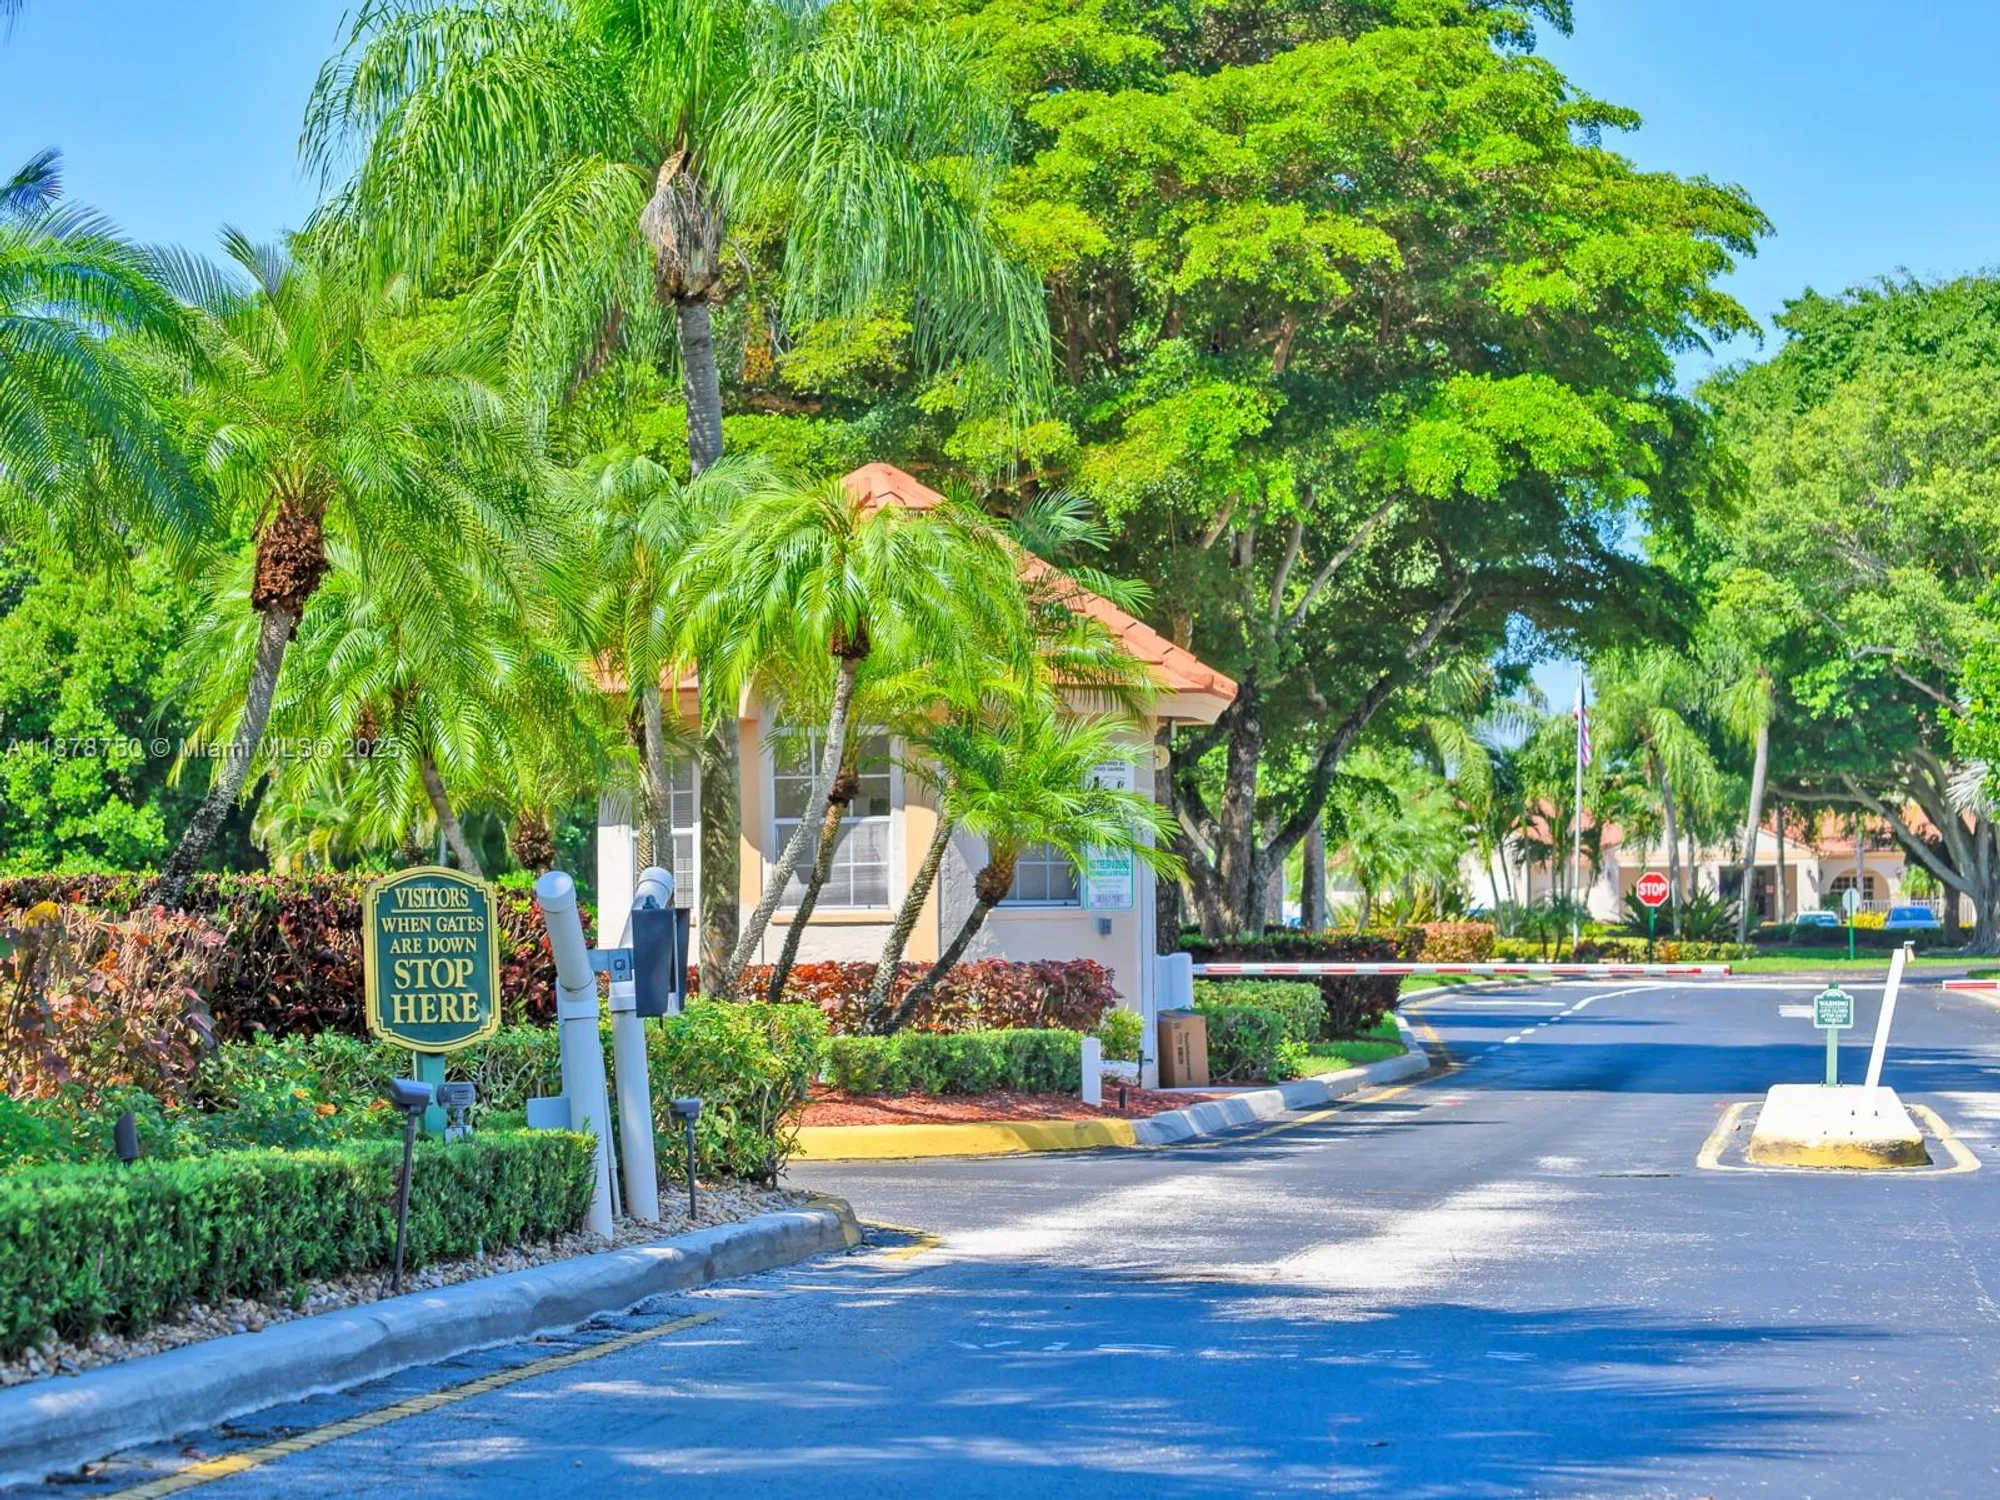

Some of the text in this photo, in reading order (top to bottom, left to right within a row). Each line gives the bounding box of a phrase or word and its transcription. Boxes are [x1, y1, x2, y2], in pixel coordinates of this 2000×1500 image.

[394, 887, 469, 908] VISITORS
[1639, 882, 1667, 897] STOP
[381, 916, 484, 932] WHEN GATES
[389, 937, 477, 954] ARE DOWN
[394, 958, 474, 989] STOP
[391, 994, 480, 1024] HERE
